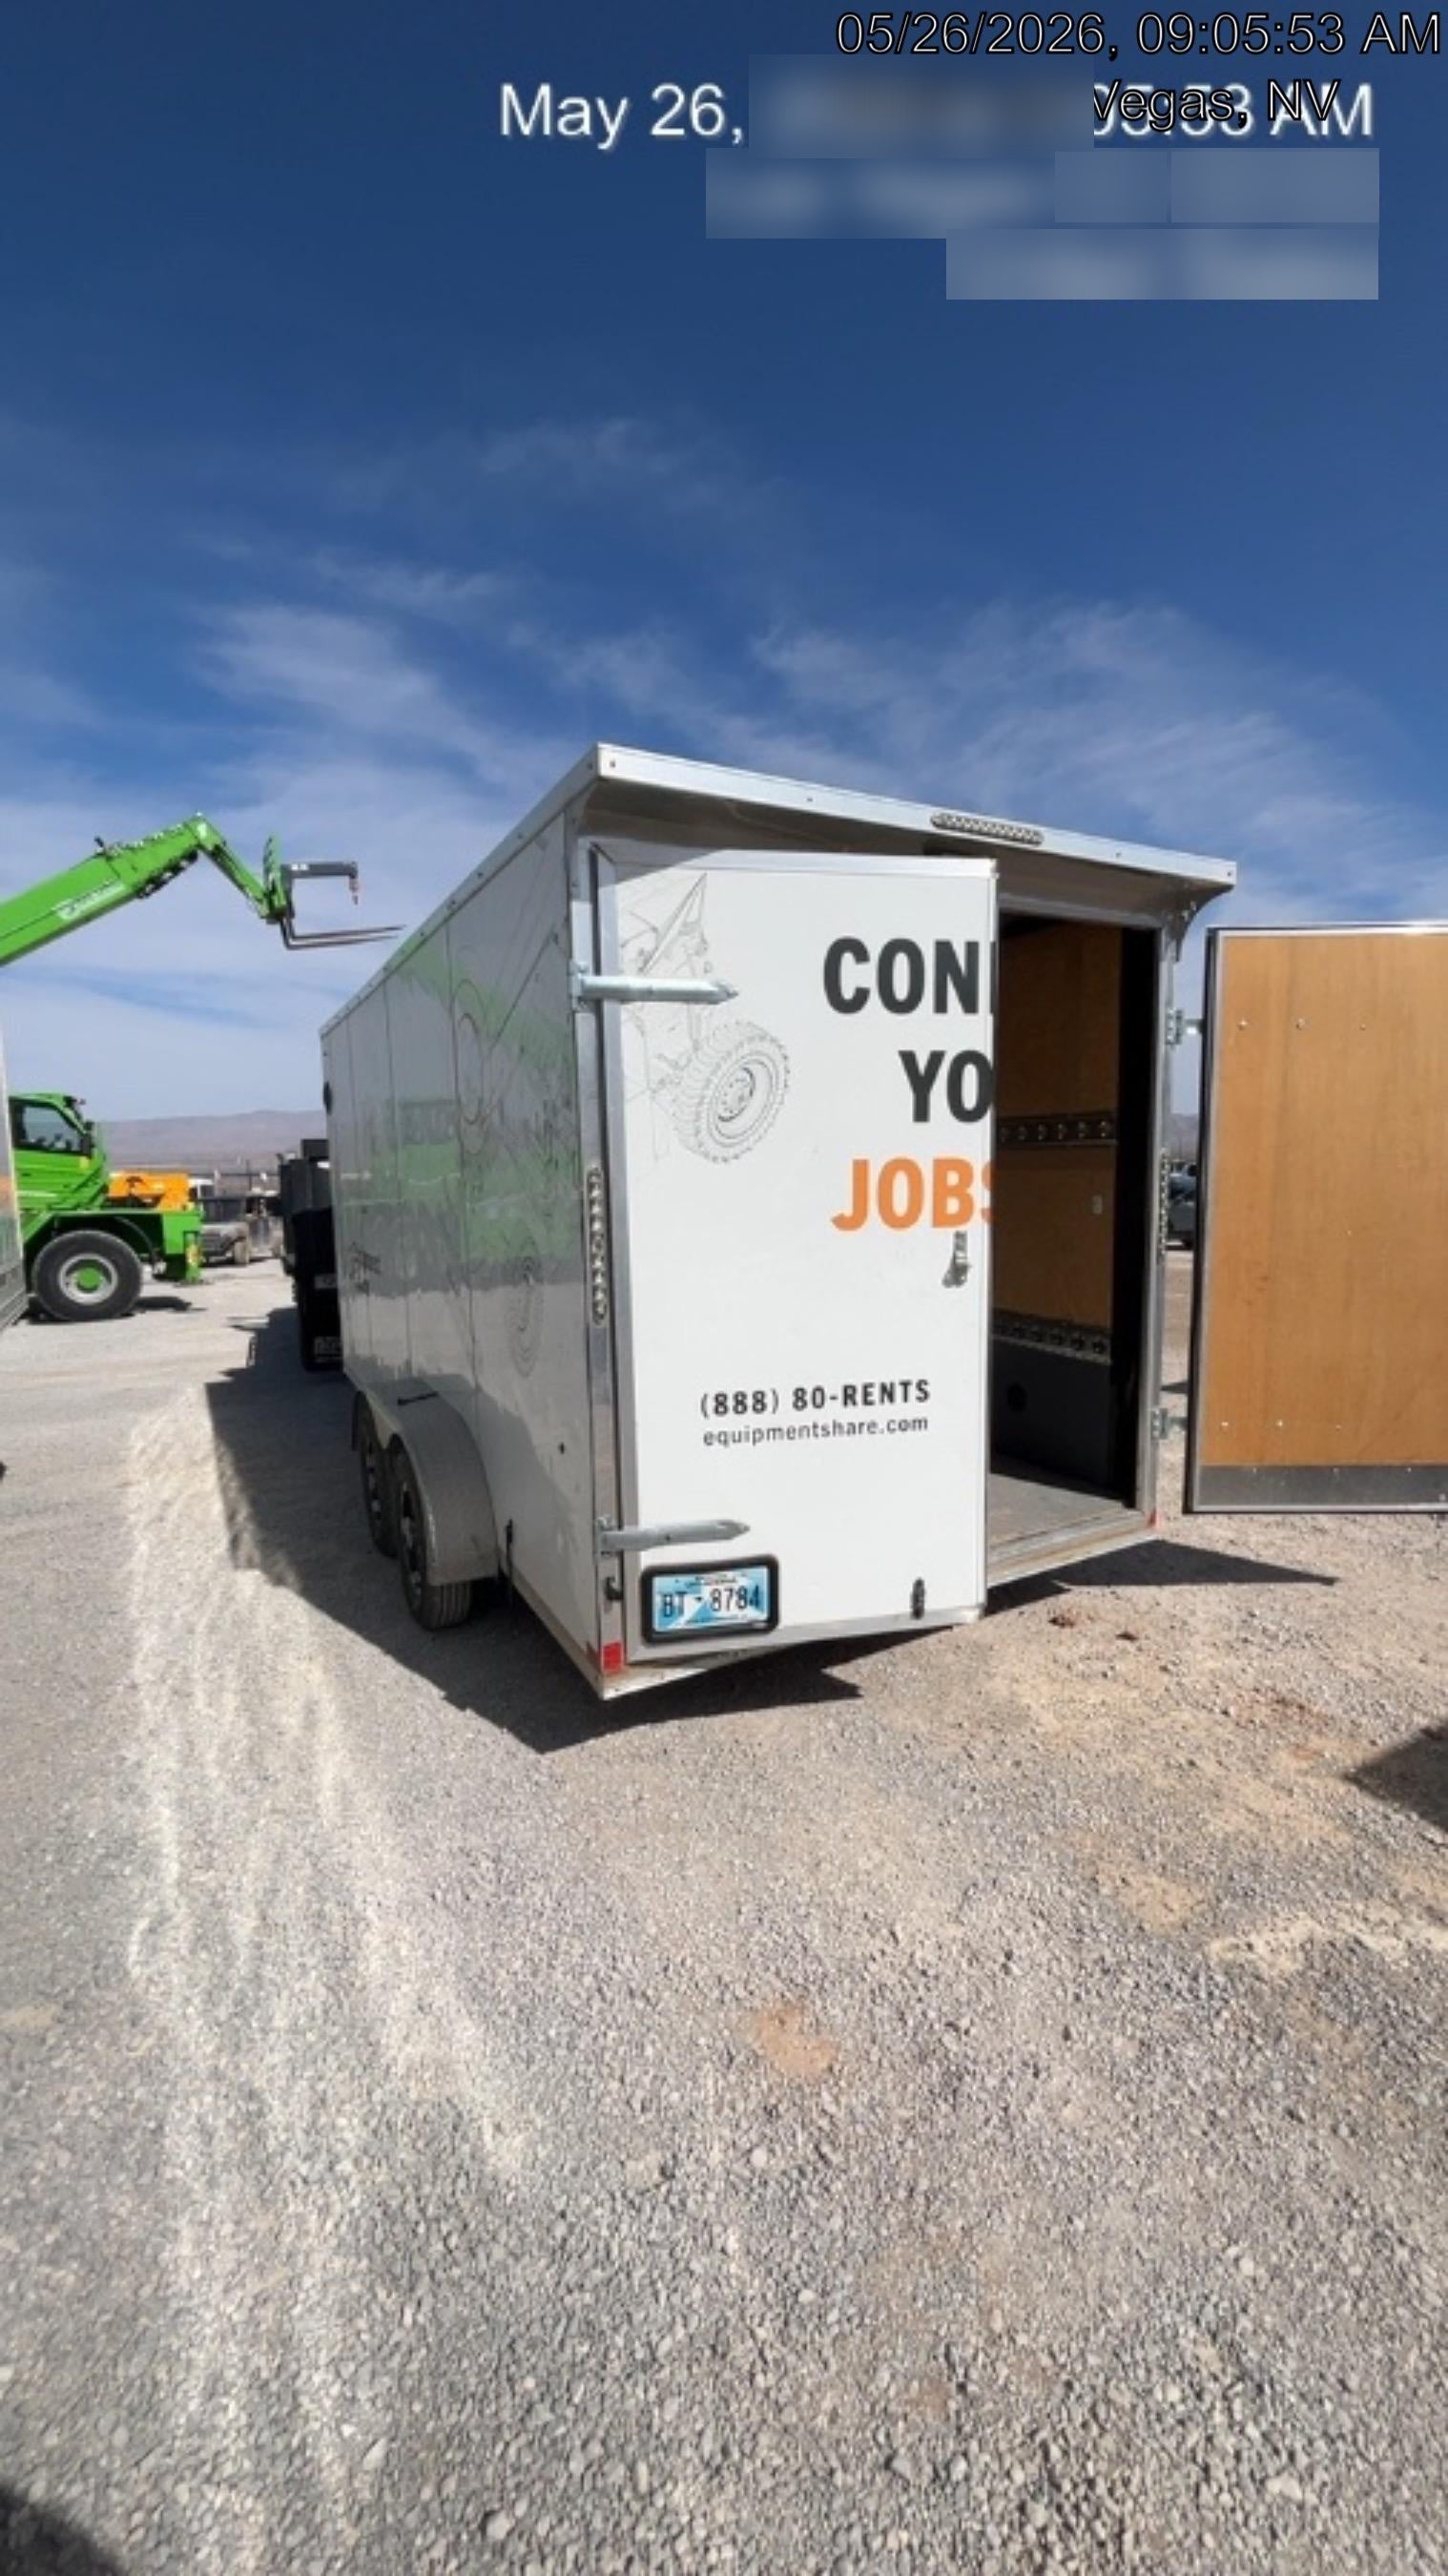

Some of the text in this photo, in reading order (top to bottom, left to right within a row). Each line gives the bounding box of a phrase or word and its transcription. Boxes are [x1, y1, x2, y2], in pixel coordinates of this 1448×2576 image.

[823, 936, 998, 1015] CON
[700, 1379, 931, 1419] (888) 80-RENTS
[702, 1416, 929, 1448] equipmentshare.com
